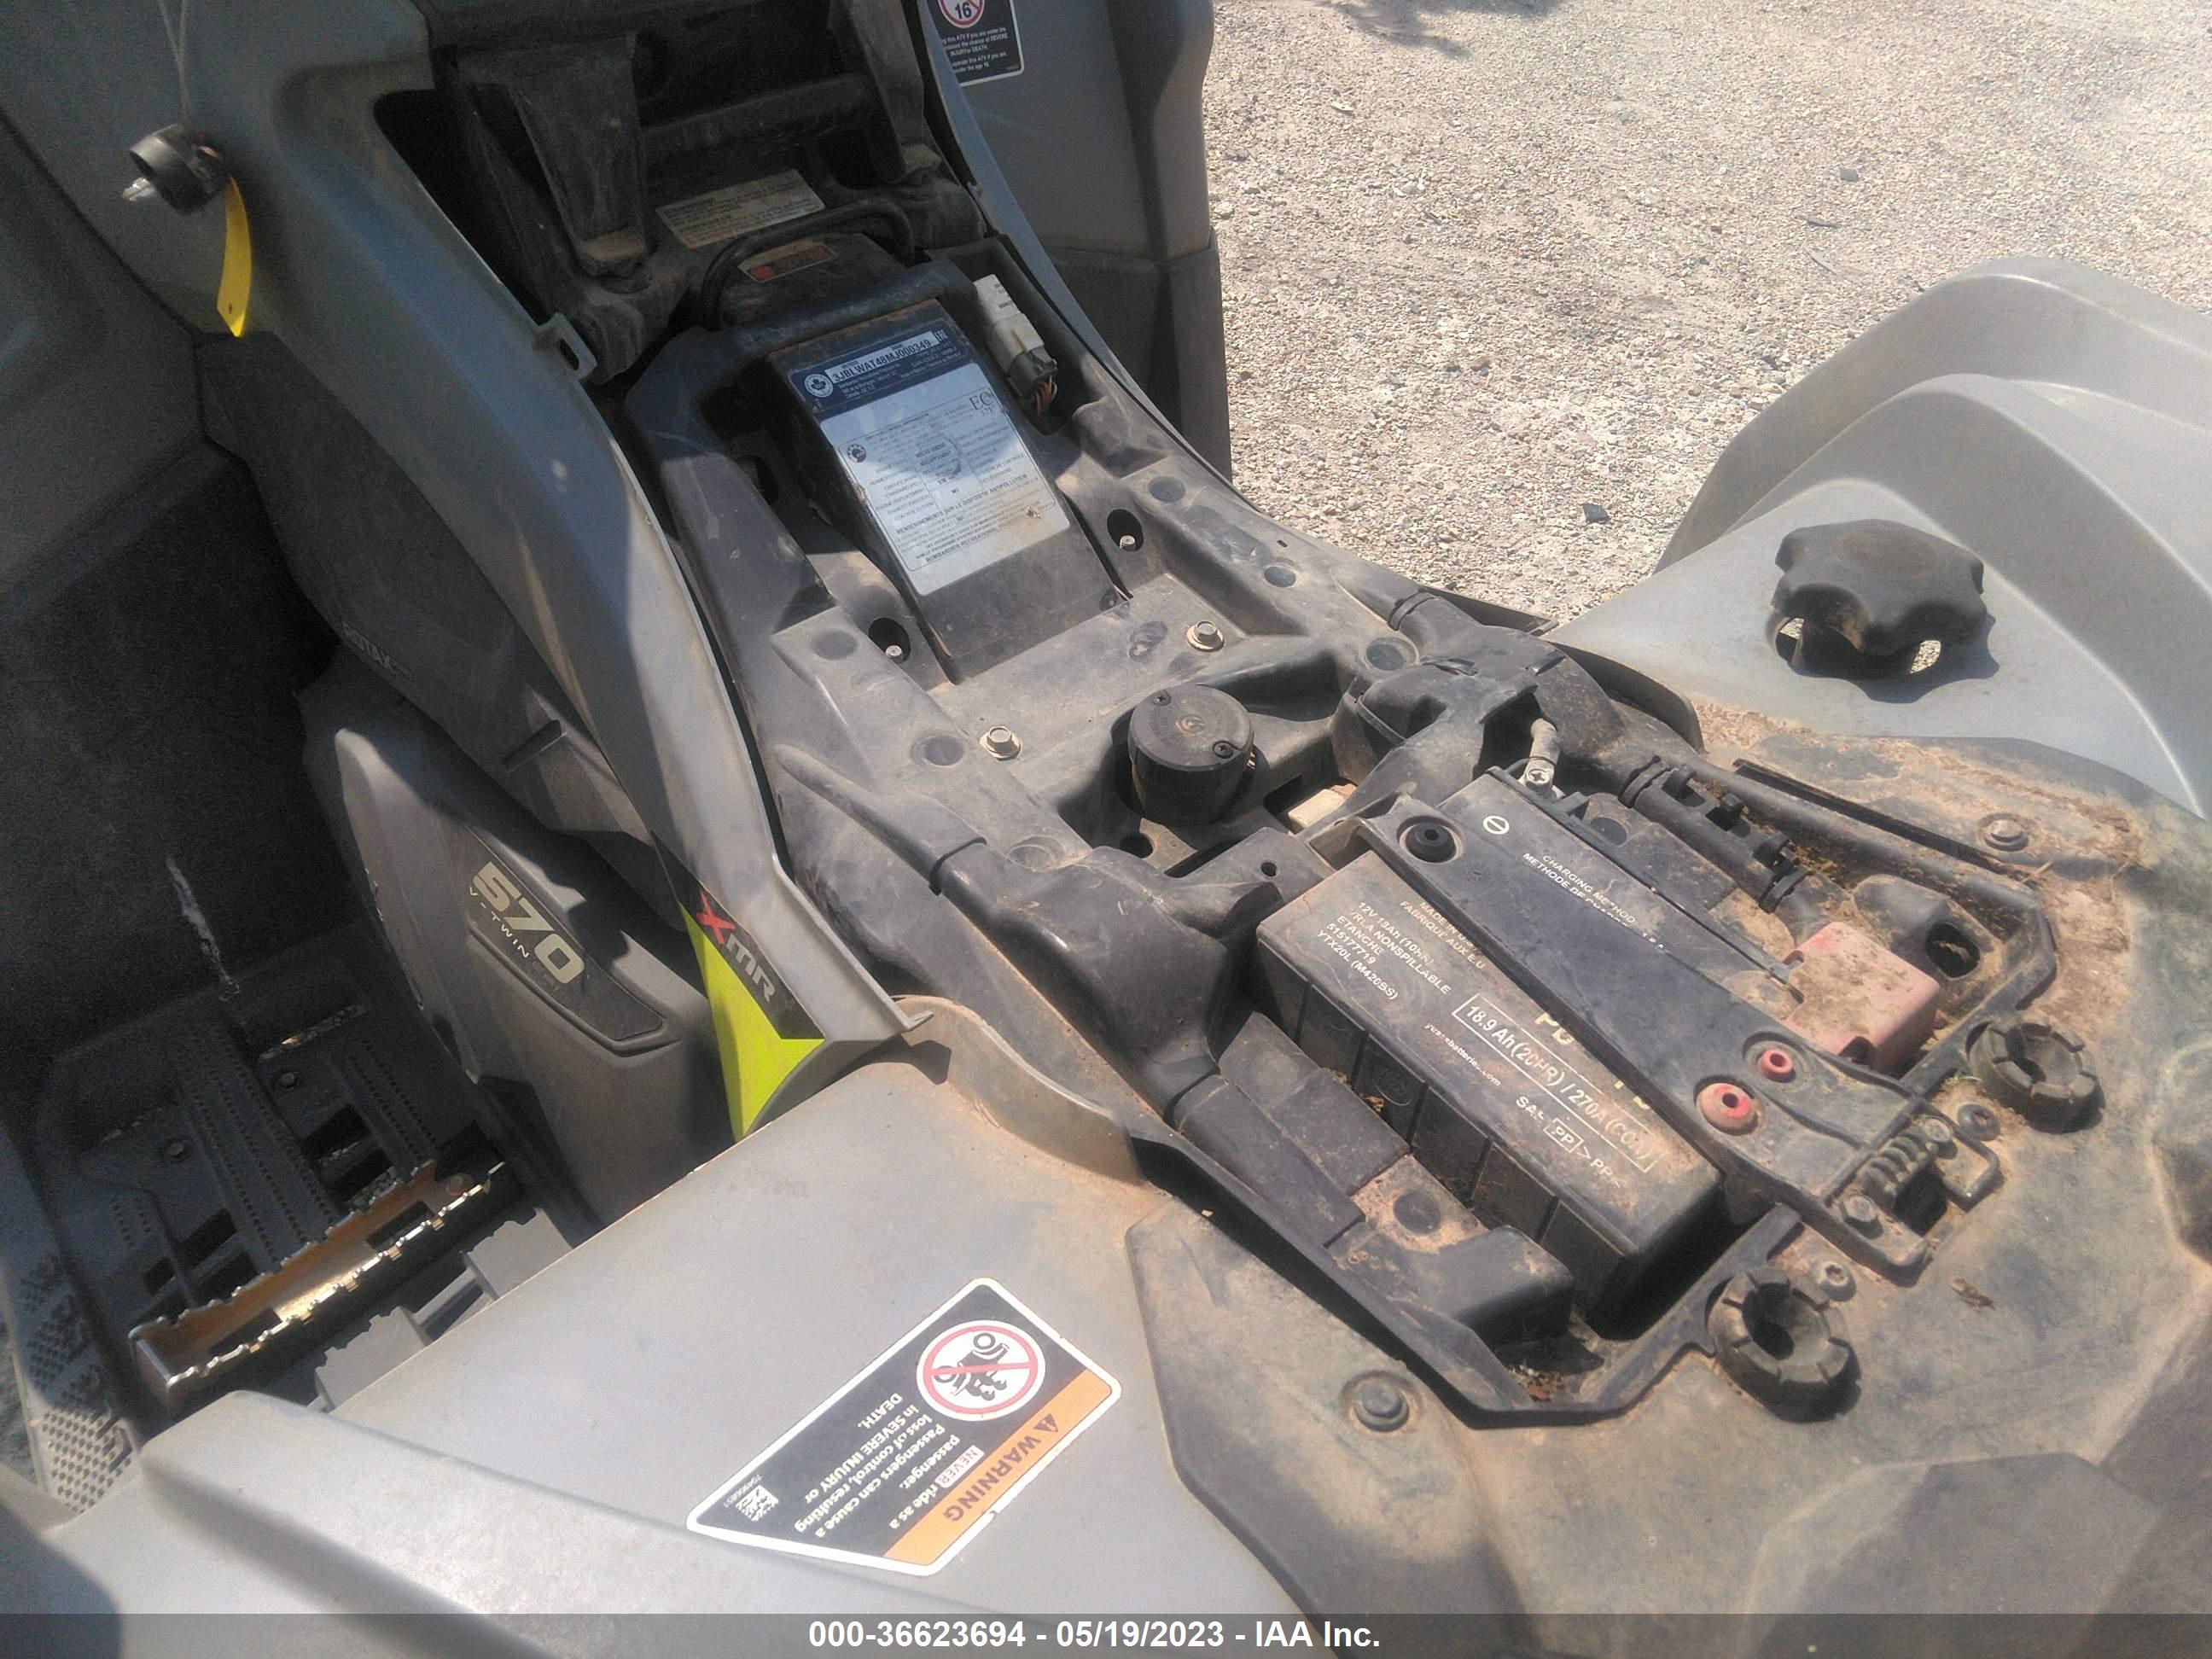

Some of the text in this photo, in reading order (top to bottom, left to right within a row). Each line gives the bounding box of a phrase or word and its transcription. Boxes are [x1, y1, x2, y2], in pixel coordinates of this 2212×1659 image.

[955, 2, 972, 19] 16
[1359, 902, 1378, 918] 12V
[1420, 902, 1447, 926] MADE
[1543, 855, 1593, 893] CHARGING
[1592, 892, 1636, 923] METHOD
[469, 887, 530, 958] V-TWIN
[473, 861, 585, 984] 570
[1318, 929, 1352, 963] YTX20L
[1326, 923, 1377, 965] 515177719
[1336, 915, 1386, 957] ETANCHE
[1400, 901, 1449, 938] FABRIQUE
[1446, 939, 1469, 955] AUX
[1374, 930, 1452, 995] NONSPILLABLE
[1466, 1005, 1498, 1032] 18.9
[858, 1394, 903, 1429] DEATH.
[794, 1414, 933, 1533] loss of control, resulting
[805, 1405, 919, 1504] in SEVERE INJURY or
[815, 1423, 946, 1538] Passengers can cause a
[899, 1435, 961, 1490] passenger.
[943, 1435, 1042, 1522] WARNING
[888, 1447, 980, 1529] NEVER ride as a
